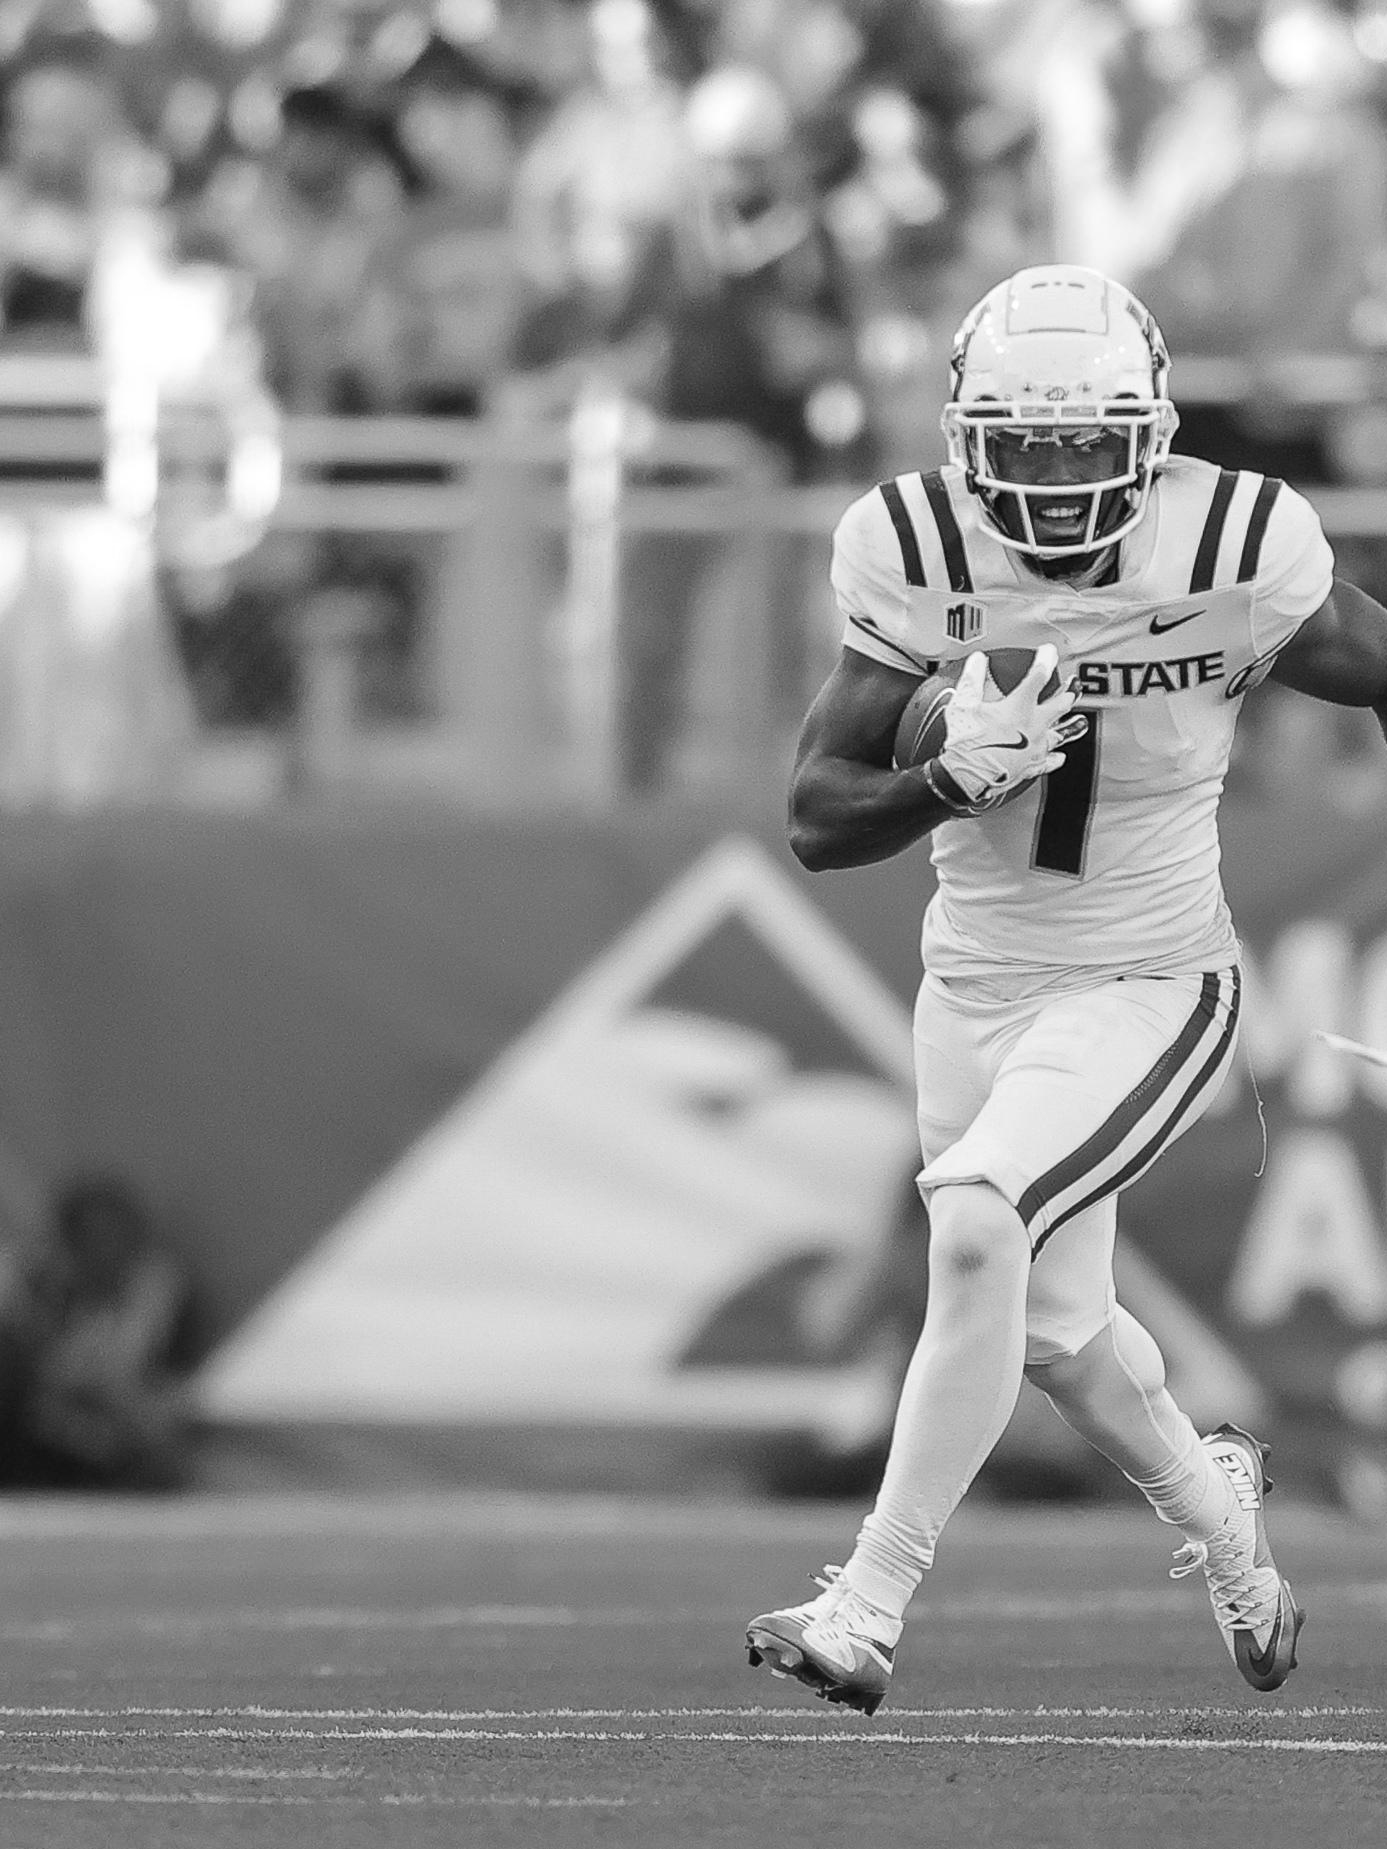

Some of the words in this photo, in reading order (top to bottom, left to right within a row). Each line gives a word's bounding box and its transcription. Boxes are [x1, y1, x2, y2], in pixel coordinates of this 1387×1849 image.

[1079, 651, 1225, 698] STATE
[1029, 705, 1101, 881] 1
[1213, 1453, 1261, 1511] NIKE
